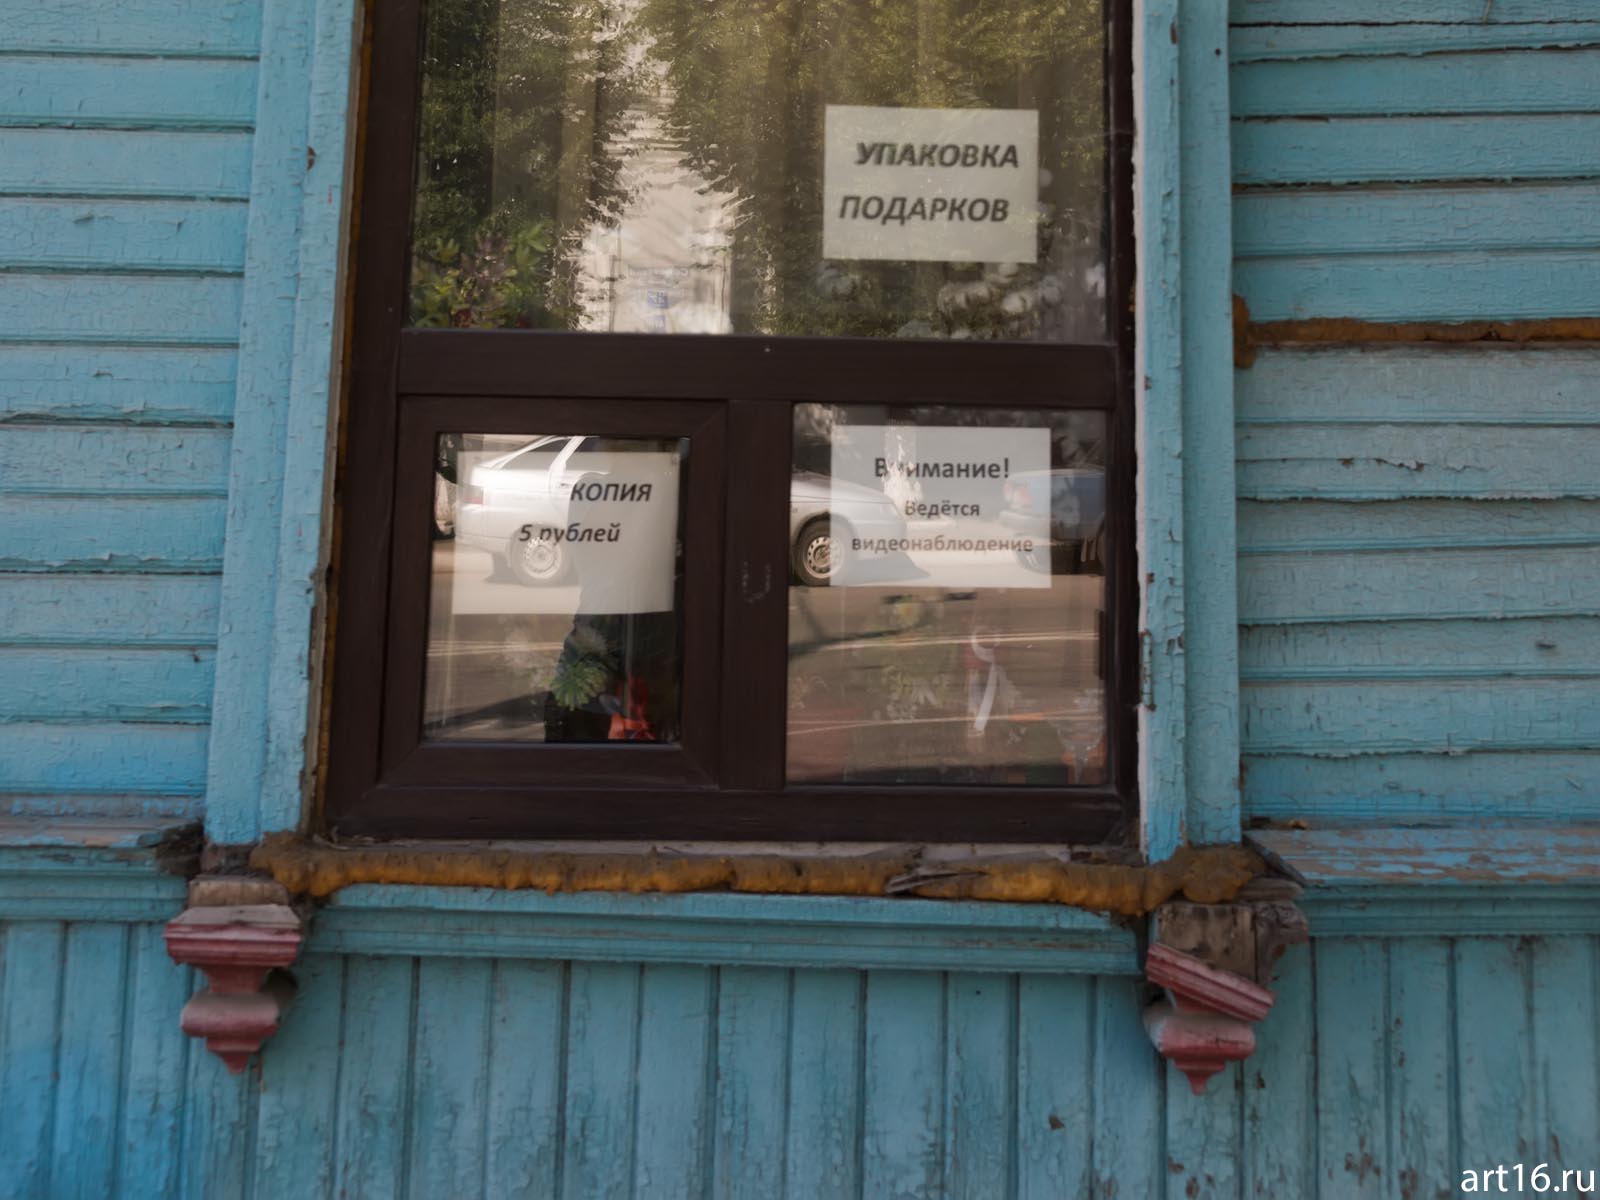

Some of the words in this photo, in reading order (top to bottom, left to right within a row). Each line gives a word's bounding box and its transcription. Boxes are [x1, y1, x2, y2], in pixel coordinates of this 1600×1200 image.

[854, 142, 1019, 168] УПАКОВКА
[839, 196, 1009, 225] ПОДАРКОВ
[904, 500, 980, 520] Ведётся
[519, 524, 533, 542] 5
[539, 523, 621, 545] рублей
[852, 535, 1033, 553] видеонаблюдение
